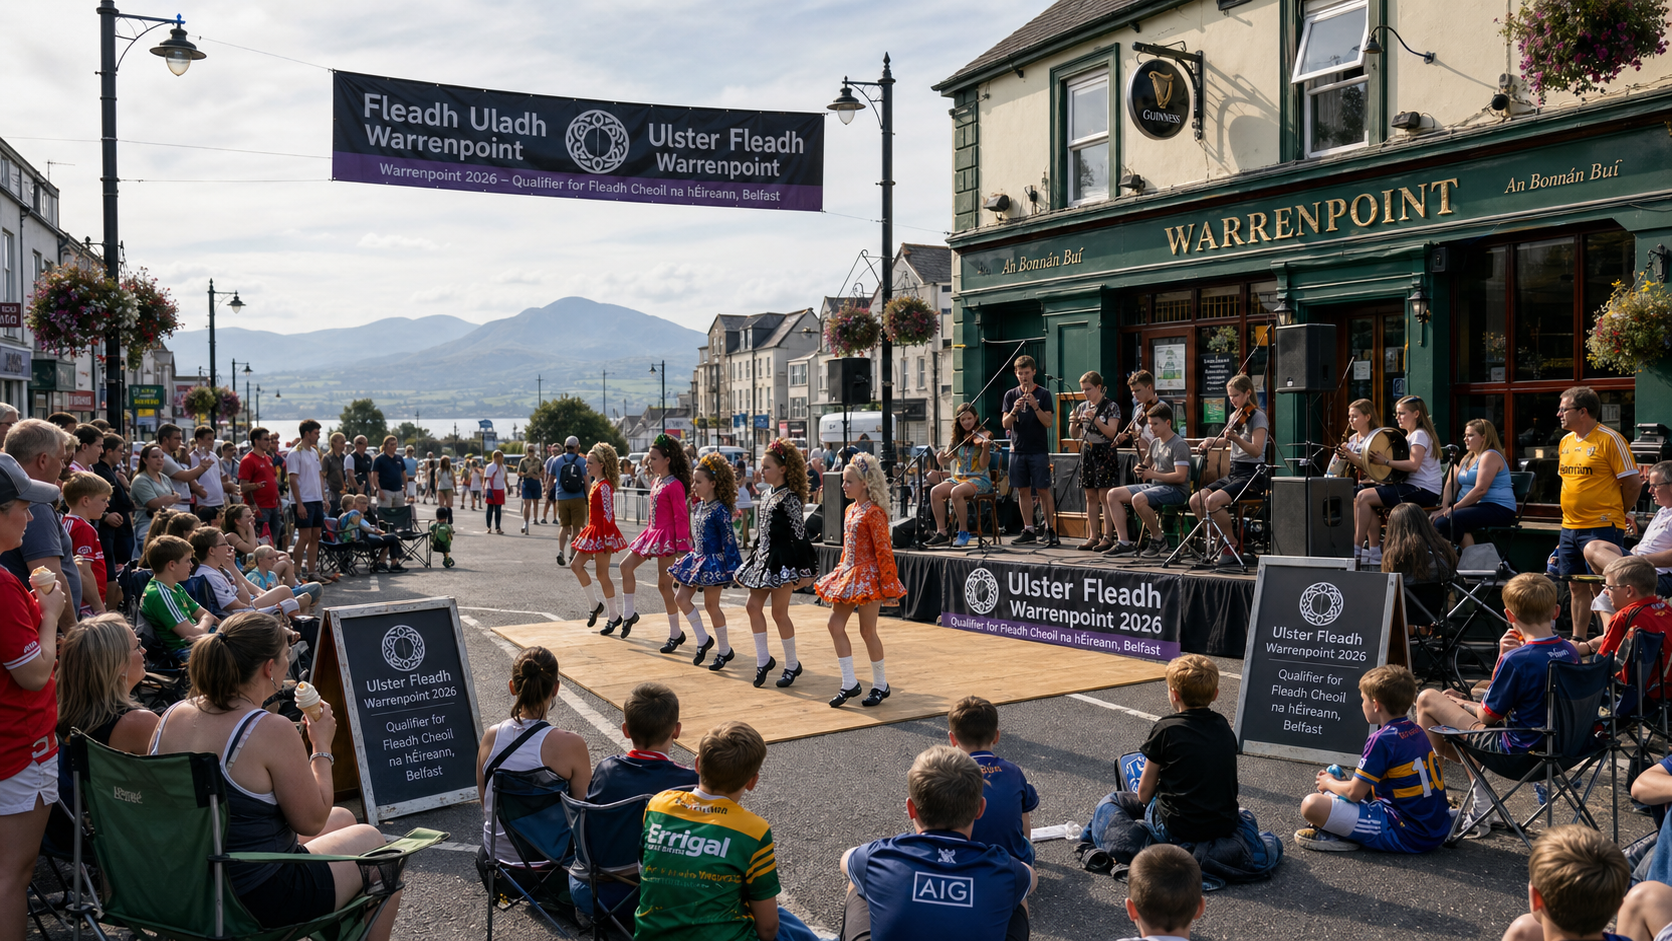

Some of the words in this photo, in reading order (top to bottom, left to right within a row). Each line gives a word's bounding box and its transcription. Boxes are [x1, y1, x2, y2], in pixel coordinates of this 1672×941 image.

[364, 92, 458, 128] Fleadh
[470, 106, 547, 137] Uladh
[1142, 109, 1181, 124] GUINNESS
[365, 124, 524, 161] Warrenpoint
[648, 123, 720, 150] Ulster
[729, 128, 804, 154] Fleadh
[656, 152, 780, 180] Warrenpoint
[1504, 177, 1525, 194] An
[1529, 167, 1585, 190] Bonnán
[1589, 158, 1623, 181] Buí
[379, 162, 462, 182] Warrenpoint
[465, 171, 498, 185] 2026
[512, 174, 564, 190] Qualifier
[568, 178, 585, 191] for
[588, 180, 627, 194] Fleadh
[631, 182, 667, 197] Cheoil
[670, 187, 684, 197] na
[687, 184, 739, 201] hÉireann,
[742, 189, 781, 202] Belfast
[1164, 177, 1458, 256] WARRENPOINT
[1001, 258, 1017, 275] An
[1018, 252, 1060, 272] Bonnán
[1062, 247, 1085, 266] Buí
[1008, 571, 1074, 601] Ulster
[1083, 578, 1162, 609] Fleadh
[1009, 600, 1115, 629] Warrenpoint
[1119, 611, 1163, 635] 2026
[950, 616, 985, 631] Qualifier
[986, 620, 999, 633] for
[1000, 623, 1028, 637] Fleadh
[1030, 627, 1058, 642] Cheoil
[1060, 633, 1072, 643] na
[1074, 632, 1122, 652] hÉireann,
[1124, 640, 1161, 656] Belfast
[1272, 626, 1313, 641] Ulster
[1317, 630, 1363, 645] Fleadh
[1266, 642, 1335, 659] Warrenpoint
[1338, 649, 1367, 662] 2026
[366, 678, 406, 693] Ulster
[409, 669, 452, 686] Fleadh
[1278, 668, 1324, 684] Qualifier
[1327, 673, 1343, 685] for
[364, 691, 430, 709] Warrenpoint
[432, 685, 457, 700] 2026
[1271, 684, 1308, 698] Fleadh
[1311, 689, 1347, 703] Cheoil
[386, 717, 429, 734] Qualifier
[431, 713, 446, 725] for
[1271, 703, 1285, 713] na
[1288, 701, 1341, 722] hÉireann,
[382, 735, 419, 751] Fleadh
[421, 727, 454, 744] Cheoil
[1283, 719, 1323, 735] Belfast
[389, 757, 403, 767] na
[405, 748, 455, 765] hÉireann,
[406, 765, 443, 782] Belfast
[1411, 750, 1445, 798] 10
[646, 822, 731, 859] Errigal
[918, 878, 967, 901] AIG
